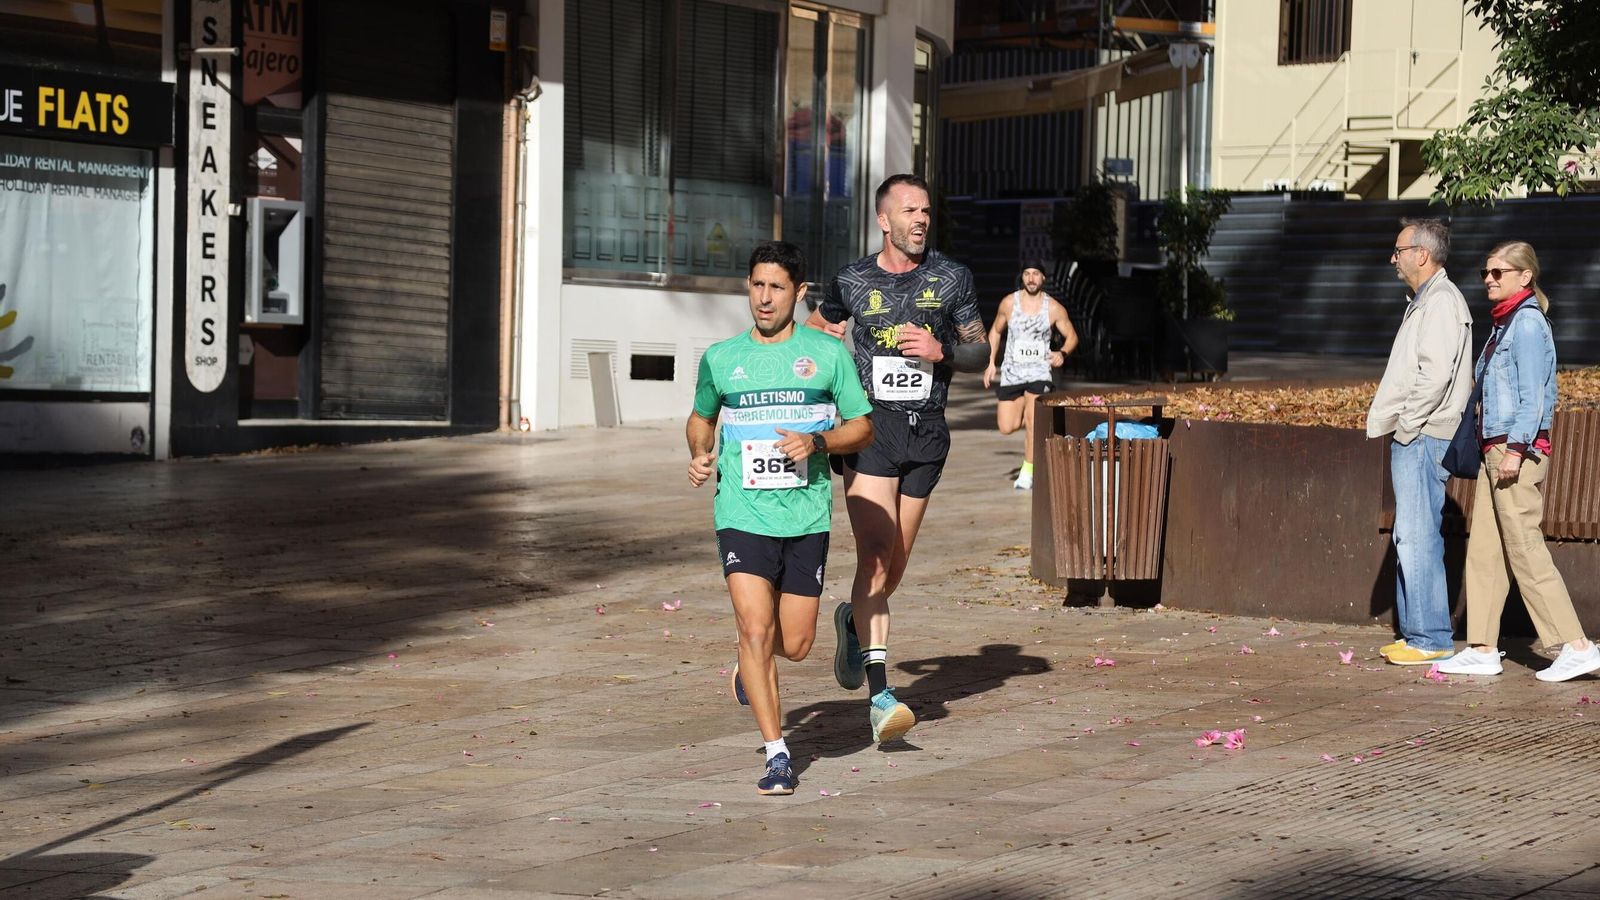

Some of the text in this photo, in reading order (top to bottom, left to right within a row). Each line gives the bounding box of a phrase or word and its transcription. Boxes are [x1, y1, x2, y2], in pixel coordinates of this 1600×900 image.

[243, 41, 299, 76] ajero
[38, 86, 129, 135] FLATS
[35, 157, 75, 173] RENTAL
[201, 16, 218, 346] SNEAKERS
[195, 356, 218, 366] SHOP
[881, 373, 923, 388] 422
[740, 391, 805, 406] ATLETISMO
[733, 407, 814, 422] TORREMOLINOS
[752, 457, 796, 474] 362
